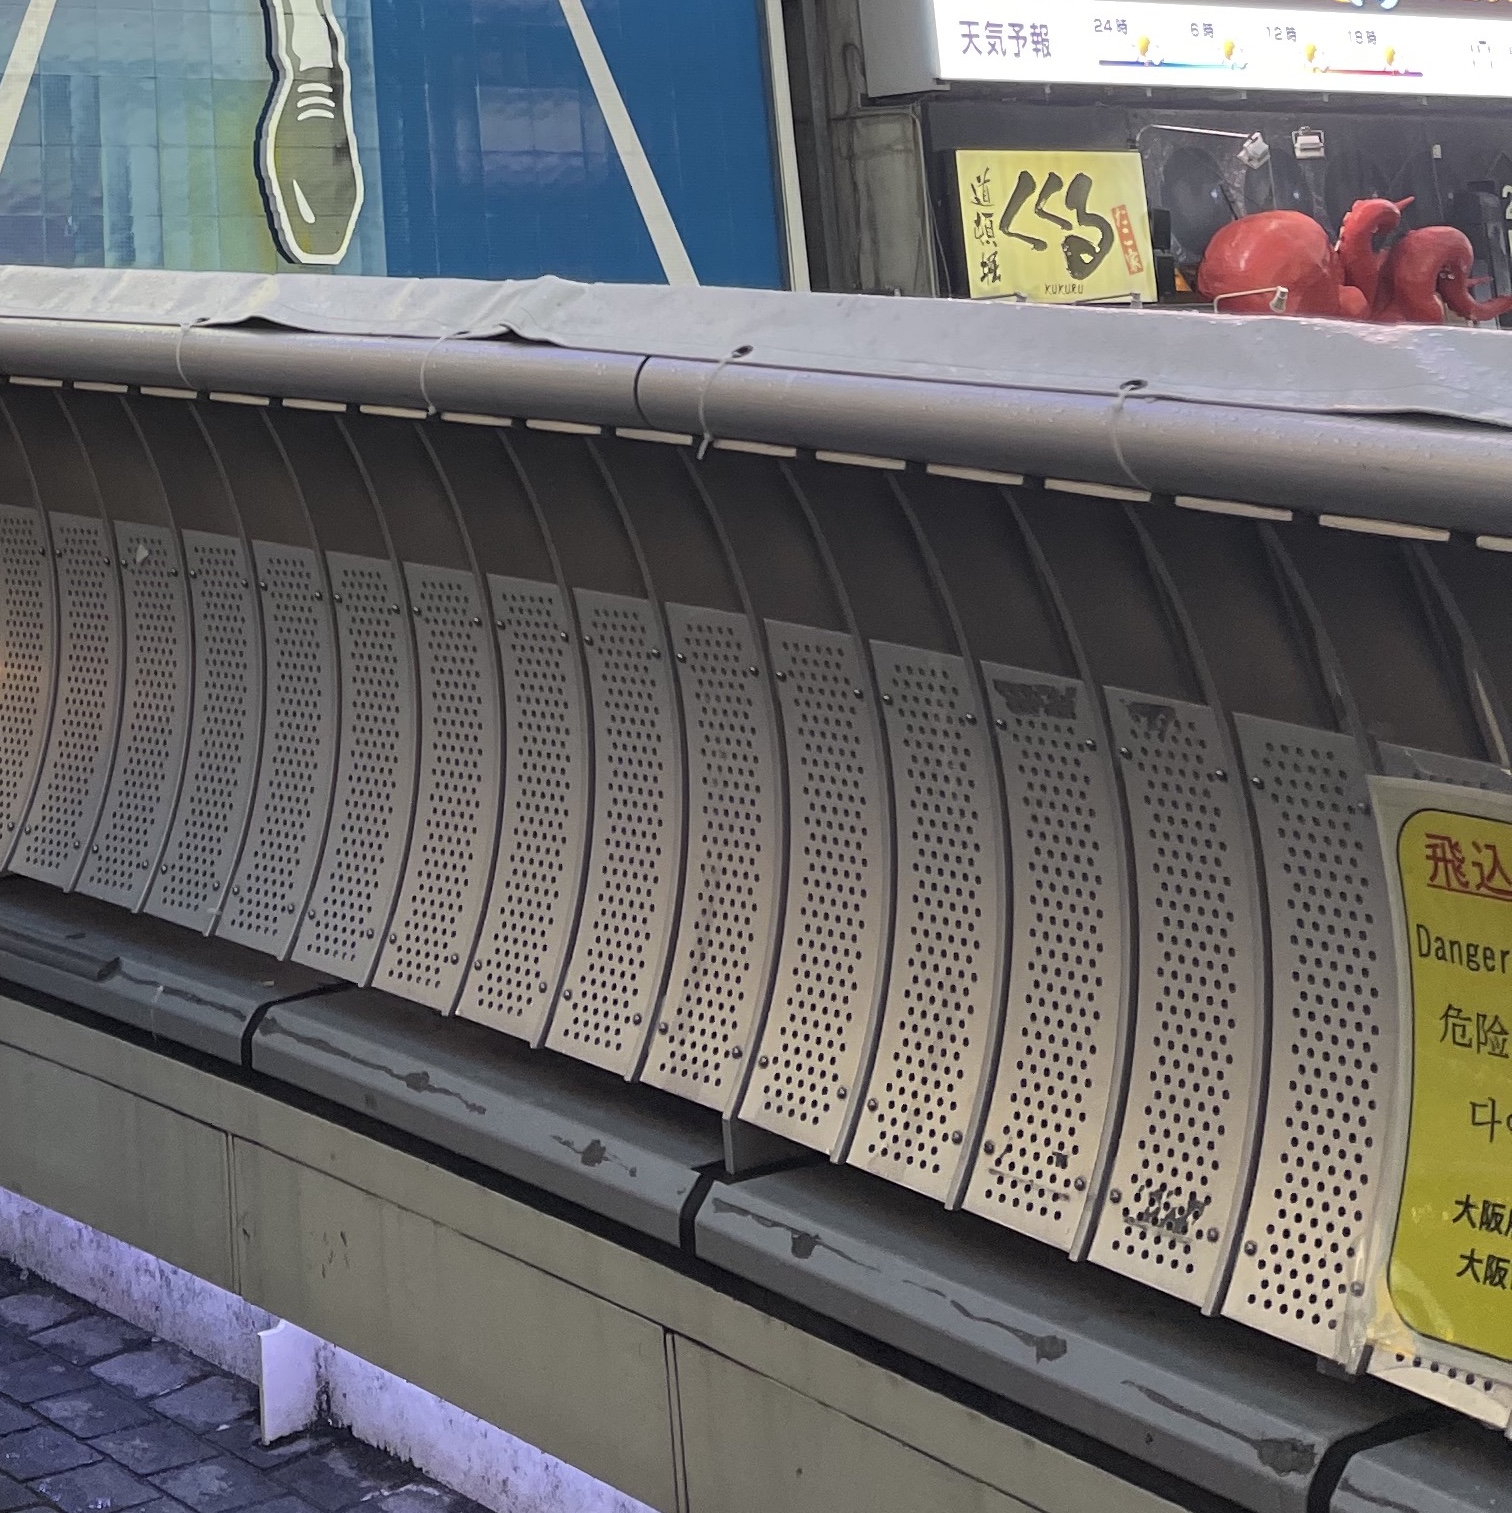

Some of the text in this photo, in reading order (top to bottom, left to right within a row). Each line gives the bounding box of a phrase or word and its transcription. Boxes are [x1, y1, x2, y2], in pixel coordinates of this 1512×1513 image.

[958, 20, 1052, 59] 天気予報
[1044, 283, 1085, 295] KUKURU
[1416, 923, 1510, 975] Danger
[1439, 1003, 1510, 1059] 危险
[1469, 1096, 1512, 1143] 다
[1452, 1194, 1512, 1237] 大阪
